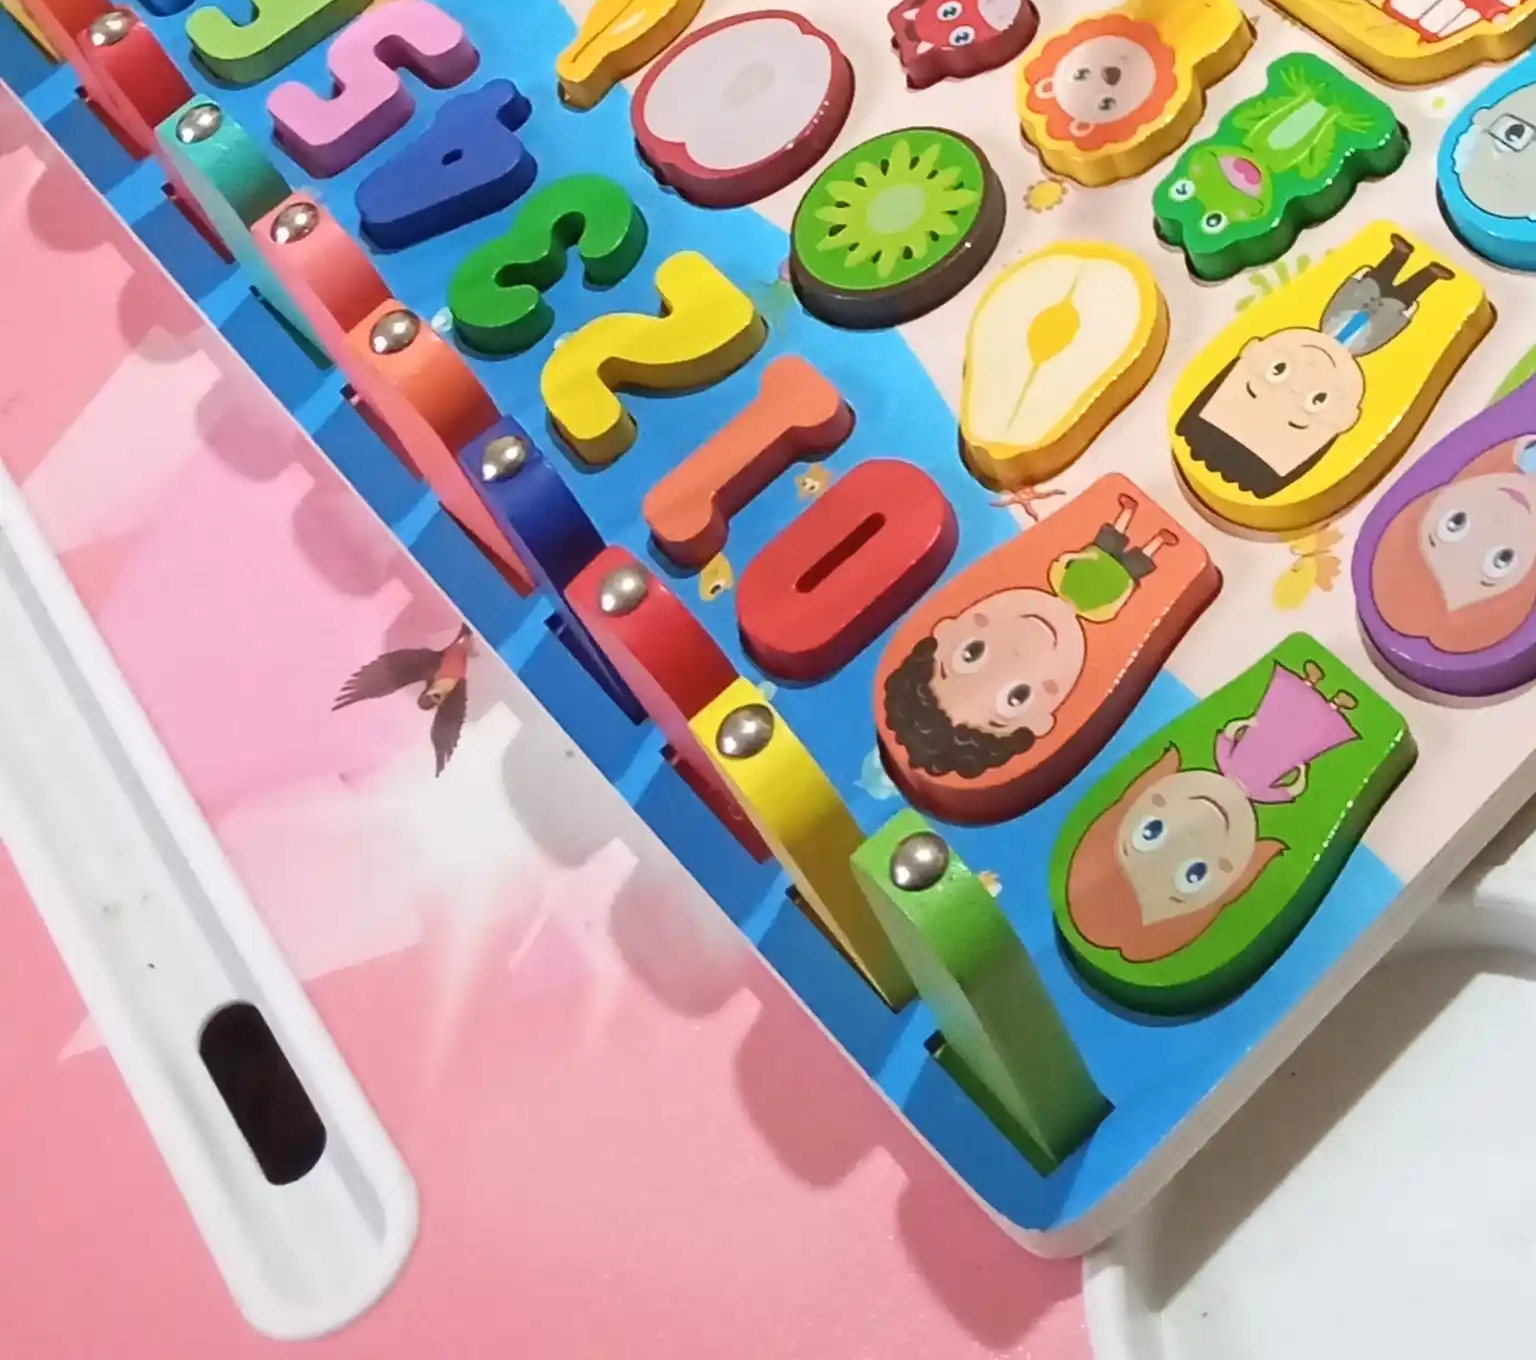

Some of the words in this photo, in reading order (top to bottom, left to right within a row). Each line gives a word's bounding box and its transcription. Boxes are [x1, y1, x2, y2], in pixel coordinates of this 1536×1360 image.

[267, 0, 480, 176] 5
[355, 79, 537, 250] 4
[447, 174, 647, 353] 3
[541, 250, 767, 465] 2
[643, 356, 853, 567] 1
[736, 458, 958, 681] 0
